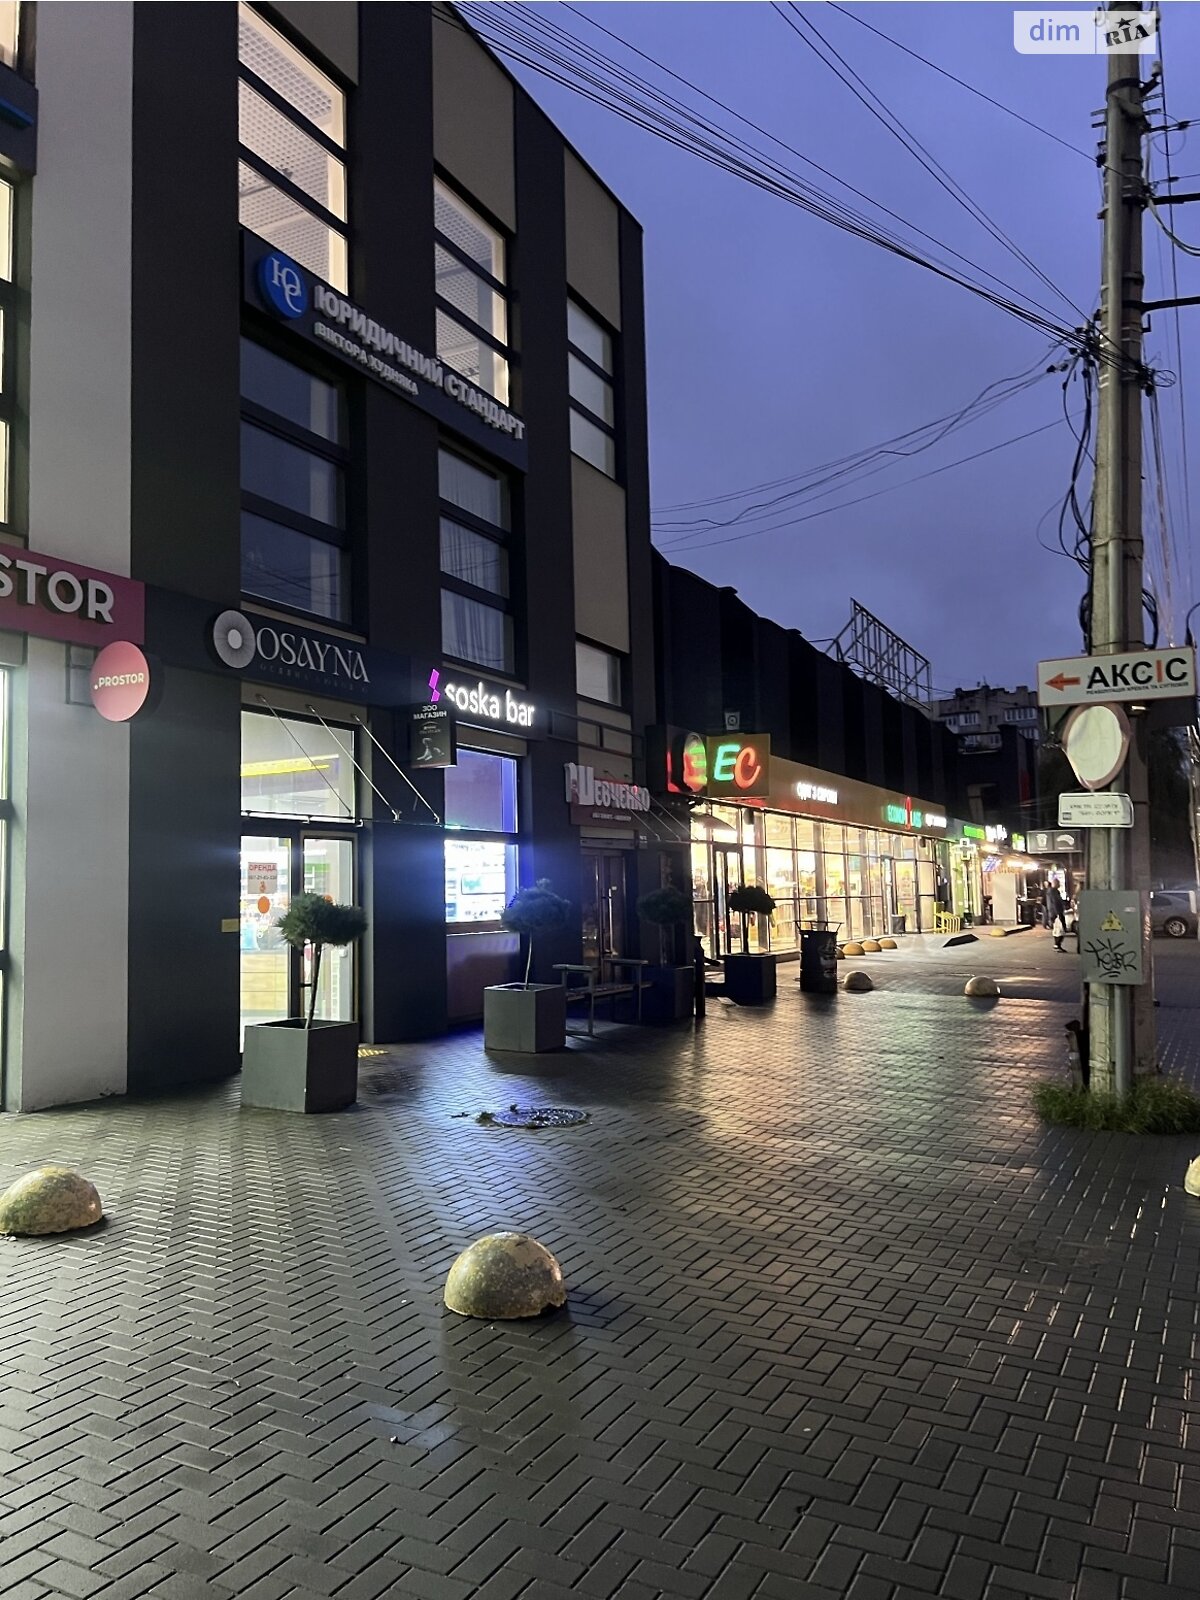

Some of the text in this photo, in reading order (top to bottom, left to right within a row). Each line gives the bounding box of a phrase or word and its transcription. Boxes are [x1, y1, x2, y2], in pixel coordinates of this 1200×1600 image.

[313, 321, 368, 364] ВІКТОРА
[314, 284, 525, 440] ЮРИДИЧНИЙ СТАНДАРТ
[256, 627, 371, 683] OSAYNA
[1086, 657, 1188, 690] АКСІС
[413, 711, 447, 720] МАГАЗИН
[445, 682, 535, 727] soska bar
[248, 864, 277, 872] ОРЕНДА
